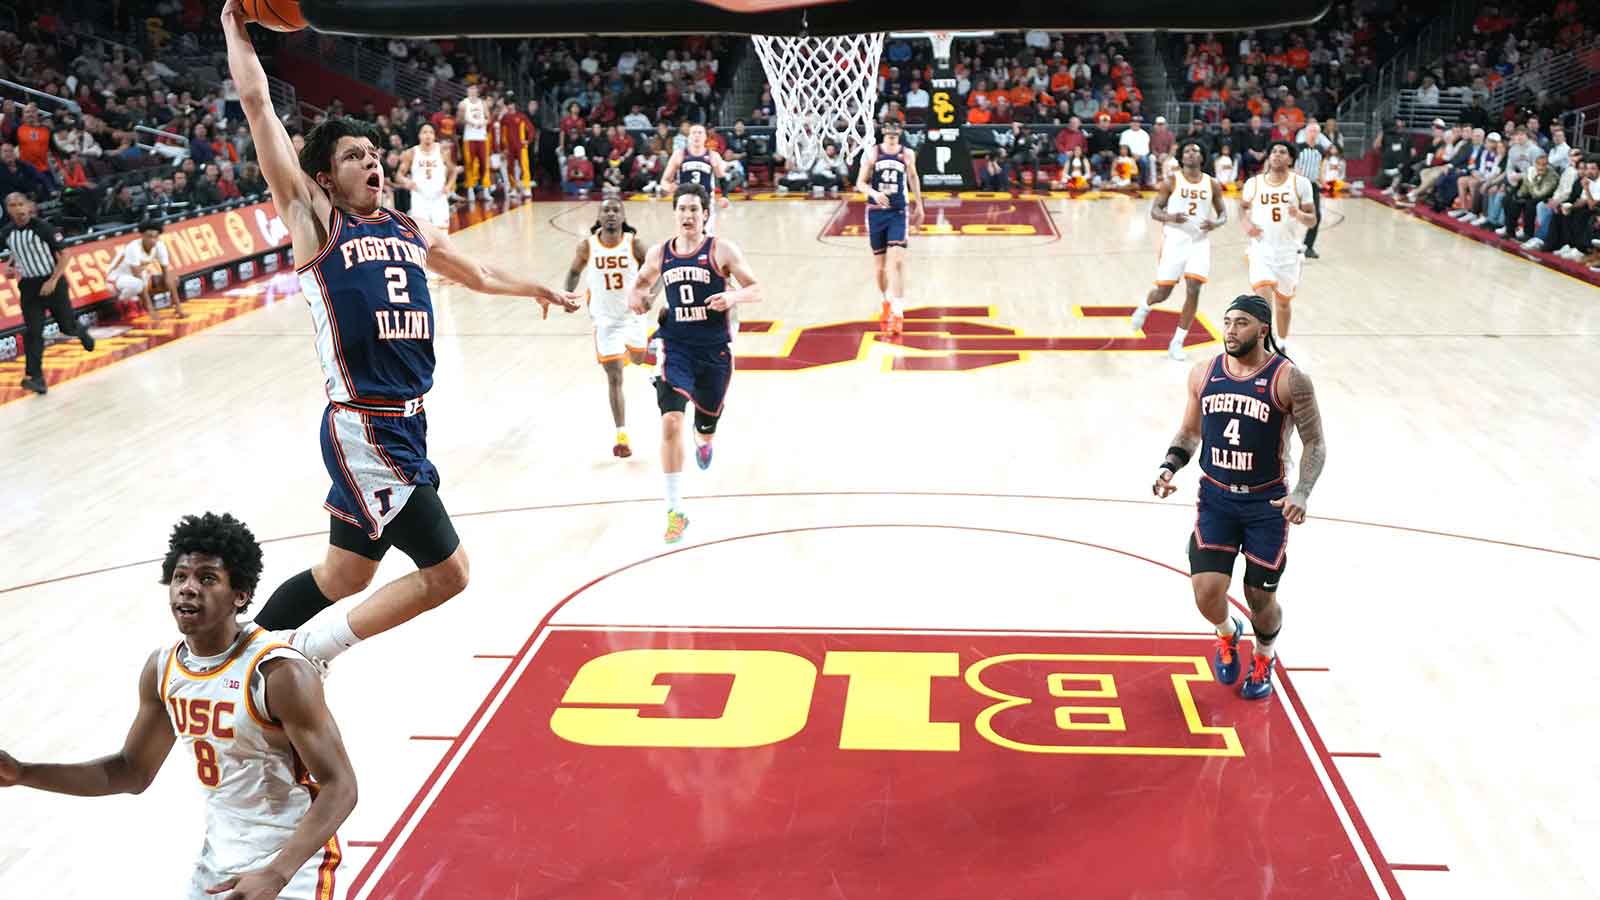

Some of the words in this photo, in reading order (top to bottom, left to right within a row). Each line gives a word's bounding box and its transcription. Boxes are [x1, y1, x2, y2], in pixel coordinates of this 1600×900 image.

[691, 171, 701, 184] 3
[881, 169, 898, 182] 44
[1181, 188, 1207, 199] USC
[1261, 192, 1290, 204] USC
[1188, 203, 1198, 216] 2
[1271, 207, 1281, 222] 6
[595, 256, 628, 269] USC
[384, 266, 411, 304] 2
[604, 272, 624, 290] 13
[679, 284, 695, 304] 0
[375, 310, 430, 340] ILLINI
[1201, 393, 1271, 423] FIGHTING
[1223, 418, 1241, 446] 4
[1211, 447, 1254, 471] ILLINI
[167, 697, 236, 739] USC
[193, 739, 220, 789] 8
